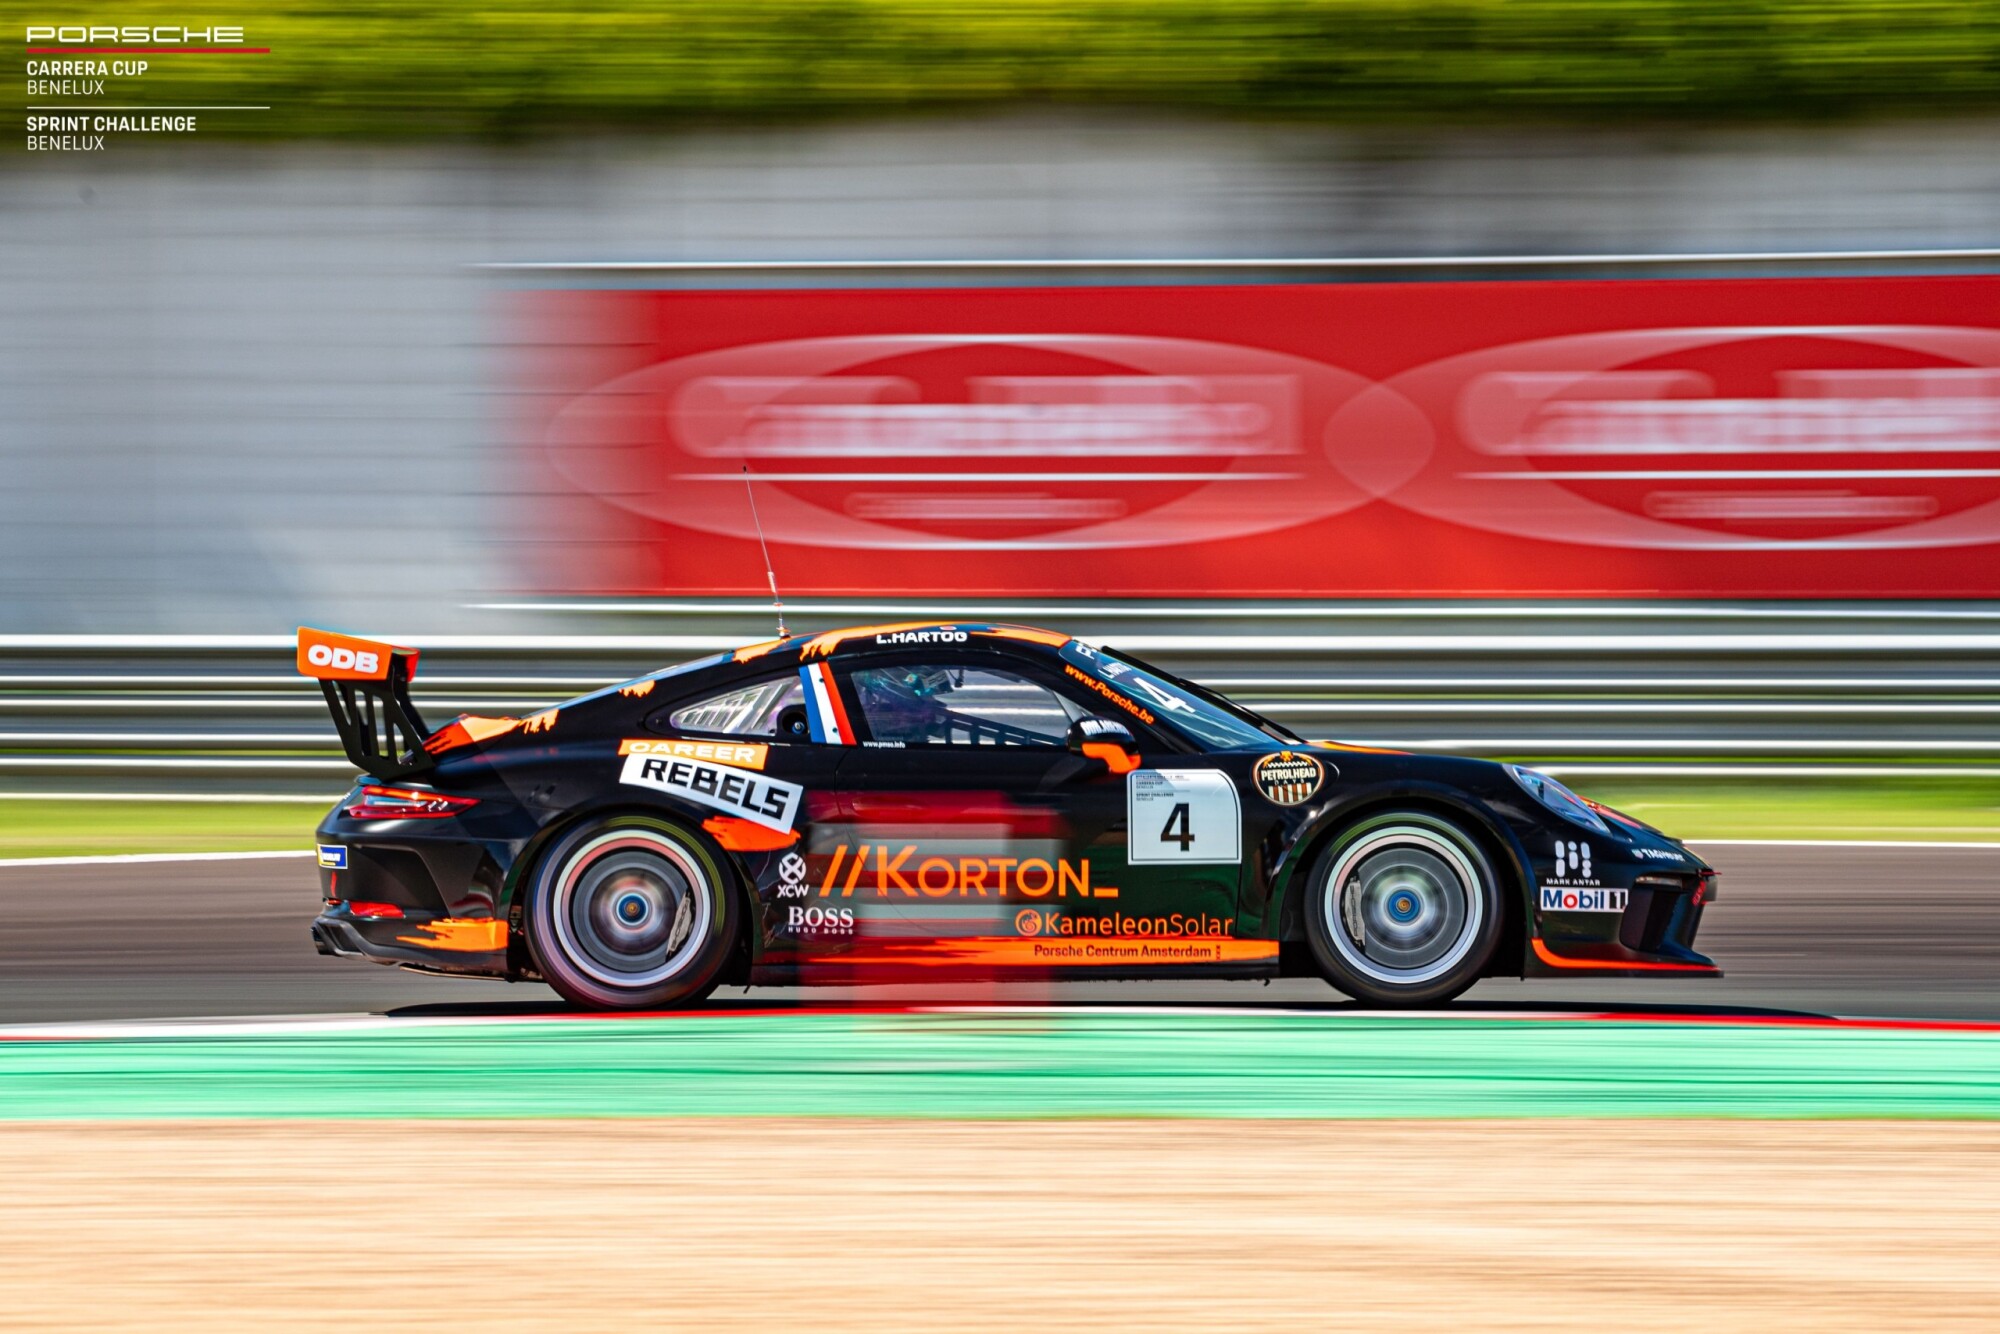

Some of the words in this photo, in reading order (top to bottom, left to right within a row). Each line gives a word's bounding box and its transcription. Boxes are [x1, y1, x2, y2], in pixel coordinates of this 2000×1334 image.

[876, 631, 968, 645] L.HARTOG
[307, 644, 379, 674] ODB
[1064, 663, 1155, 725] www.Porsche.be
[1132, 676, 1197, 714] 4
[628, 741, 757, 763] CAREER
[1260, 767, 1317, 782] PETROLHEAD
[640, 758, 790, 821] REBELS
[1160, 802, 1196, 852] 4
[776, 883, 810, 898] XCW
[1546, 877, 1571, 886] MARK
[1572, 878, 1601, 887] ANTAR
[1543, 889, 1605, 909] Mobil
[788, 905, 855, 928] BOSS
[1044, 911, 1234, 936] KameleonSolar
[788, 926, 818, 934] HUGO
[1034, 944, 1084, 957] Porsche
[1085, 944, 1139, 957] Centrum
[1140, 944, 1212, 957] Amsterdam
